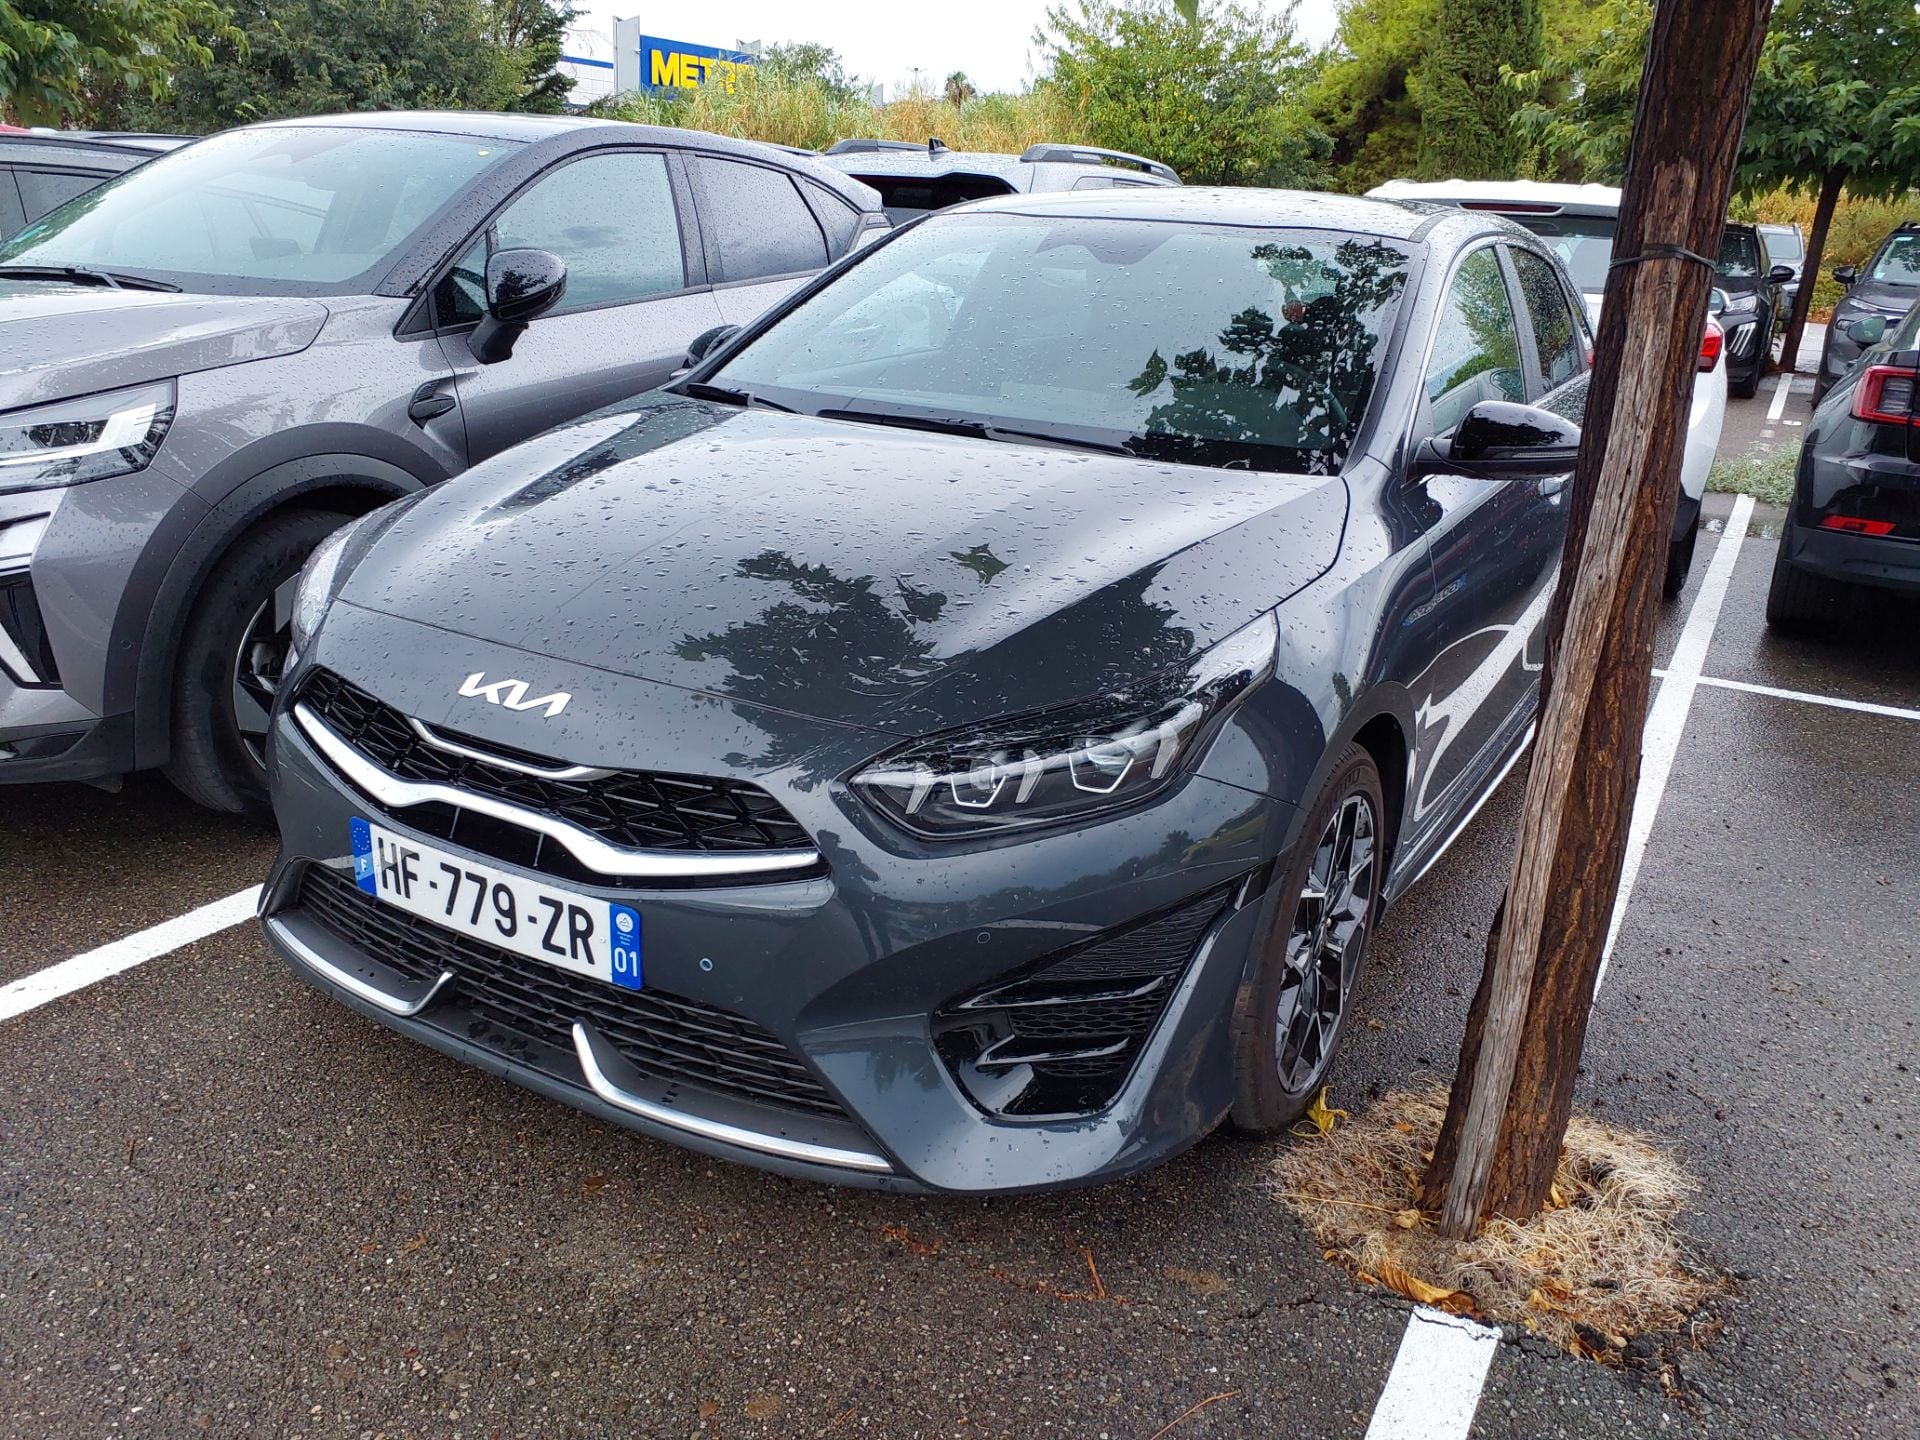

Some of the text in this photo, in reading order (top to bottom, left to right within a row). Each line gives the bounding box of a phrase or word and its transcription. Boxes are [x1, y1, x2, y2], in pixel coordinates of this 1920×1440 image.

[458, 672, 572, 718] KIA
[360, 858, 368, 873] F
[378, 836, 595, 965] HF-779-ZR
[614, 947, 638, 977] 01
